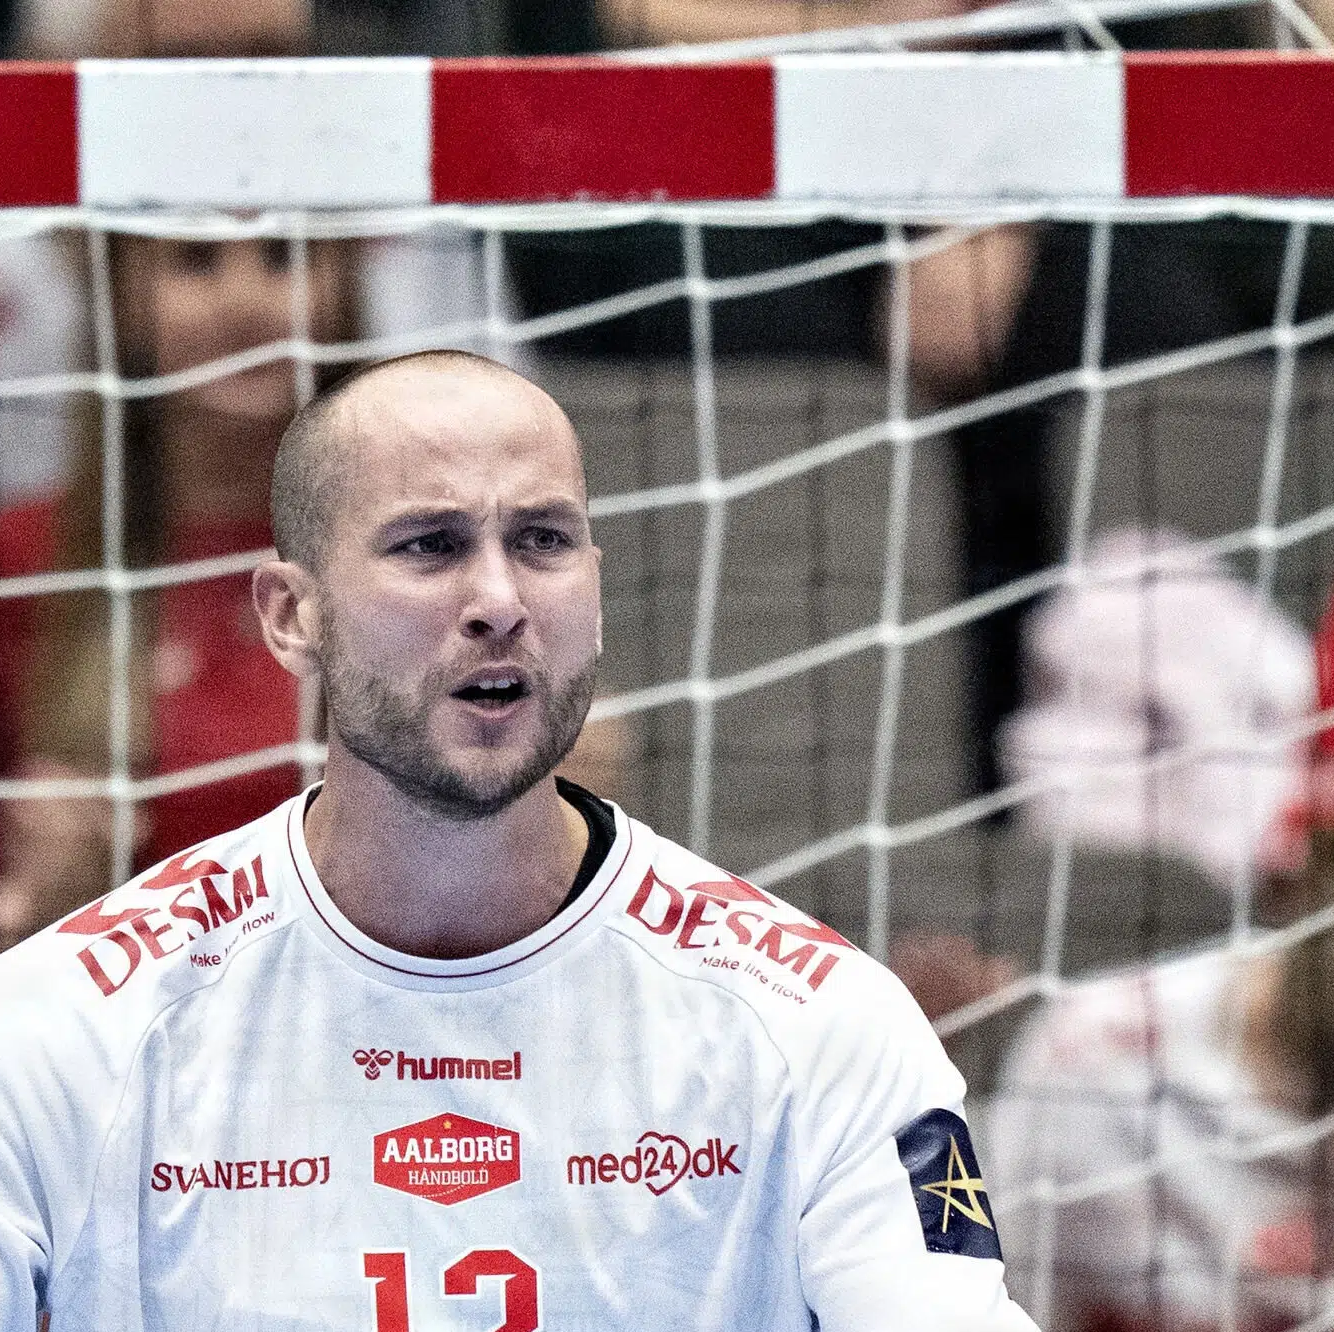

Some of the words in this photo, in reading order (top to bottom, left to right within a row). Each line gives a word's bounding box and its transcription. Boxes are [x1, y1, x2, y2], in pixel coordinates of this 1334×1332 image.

[76, 853, 270, 997] DESMI
[189, 952, 222, 968] Make
[242, 911, 275, 935] flow
[626, 864, 840, 992] DESMI
[699, 956, 740, 970] Make
[396, 1051, 521, 1081] hummel
[381, 1135, 513, 1164] AALBORG
[567, 1134, 742, 1194] med24.dk
[150, 1155, 331, 1194] SVANEHØJ
[408, 1167, 489, 1186] HÅNDBOLD
